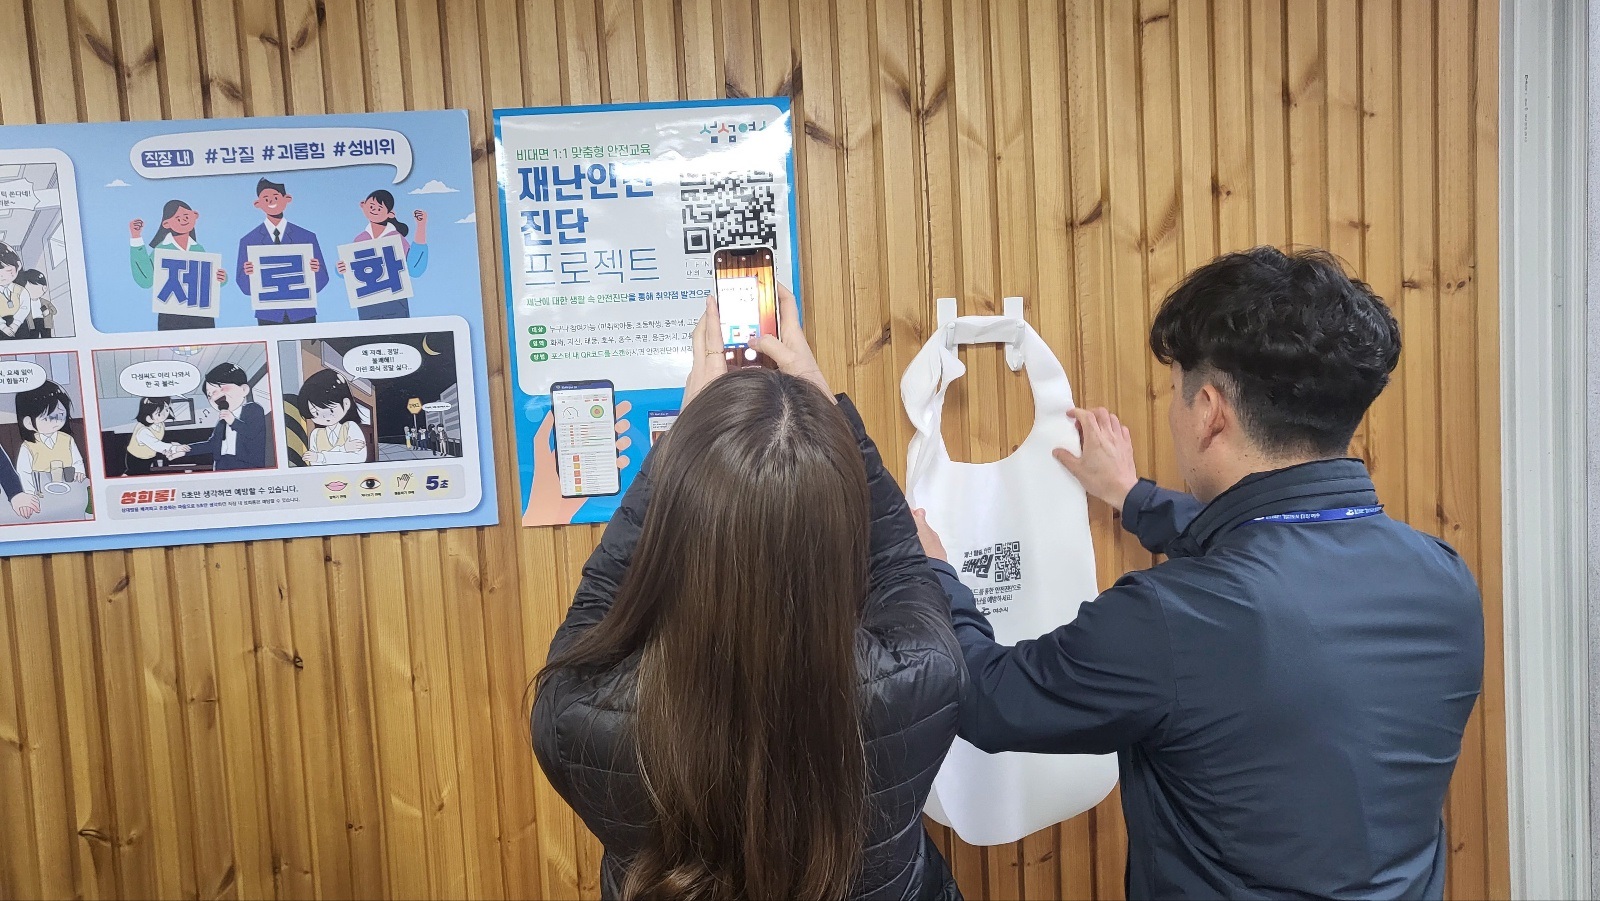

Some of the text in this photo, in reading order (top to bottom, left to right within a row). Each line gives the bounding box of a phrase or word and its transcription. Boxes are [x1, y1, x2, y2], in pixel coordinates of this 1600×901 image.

[145, 150, 191, 167] 직장 내
[205, 138, 395, 164] #갑질 #괴롭힘 #성비위
[516, 143, 651, 161] 비대면 1:1 맞춤형 안전교육
[521, 208, 589, 246] 진단
[525, 248, 659, 286] 프로젝트
[157, 246, 406, 309] 제 로 화
[526, 297, 550, 306] 재난에
[552, 296, 568, 306] 대한
[570, 295, 585, 305] 생활
[587, 295, 596, 303] 속
[597, 292, 636, 304] 안전진단을
[638, 291, 654, 301] 통해
[655, 290, 679, 300] 취약점
[681, 289, 711, 299] 발견으로
[550, 325, 569, 333] 누구나
[570, 323, 596, 332] 참여가능
[551, 351, 571, 359] 포스터
[581, 349, 611, 358] QR코드를
[121, 489, 177, 504] 성희롱!
[181, 490, 201, 499] 5초만
[203, 489, 232, 498] 생각하면
[234, 487, 256, 496] 예방할
[267, 485, 299, 494] 있습니다.
